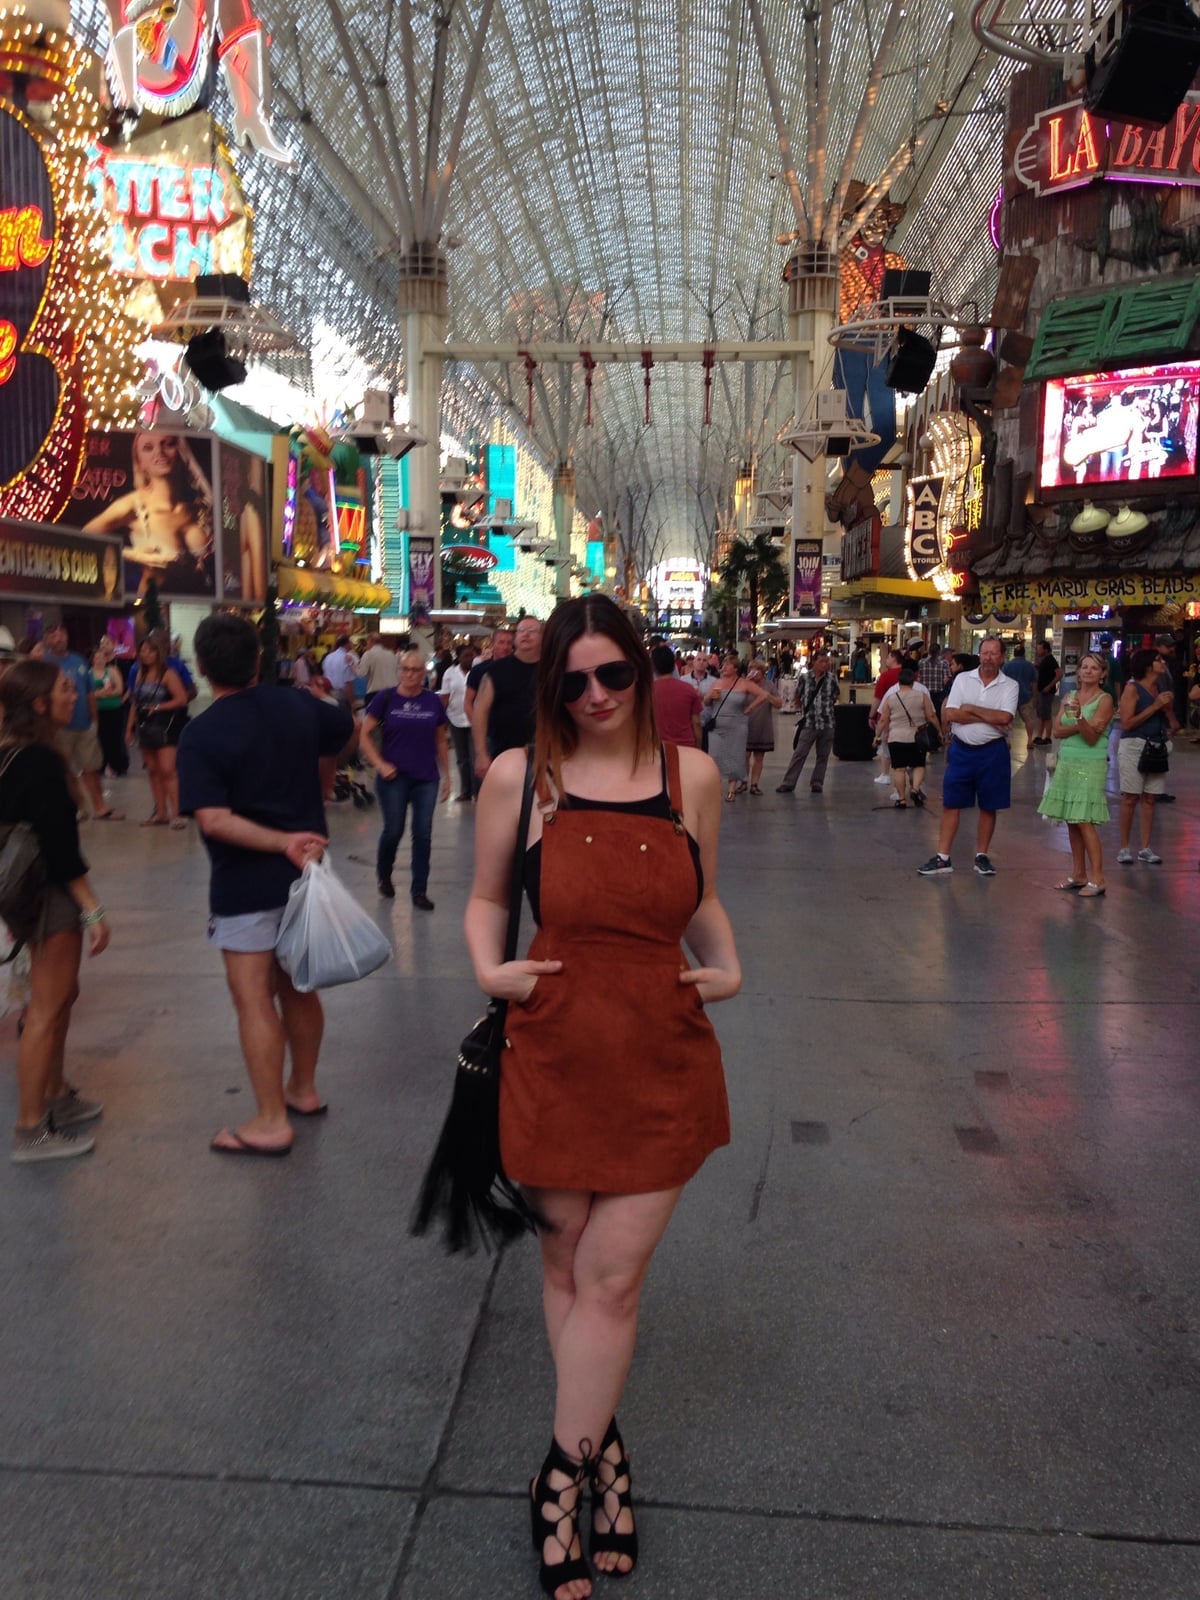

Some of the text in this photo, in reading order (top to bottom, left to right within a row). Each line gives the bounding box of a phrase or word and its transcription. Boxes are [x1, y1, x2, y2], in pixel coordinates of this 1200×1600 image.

[1048, 102, 1200, 182] LA BAY
[80, 466, 127, 488] ATED
[912, 483, 939, 555] ABC
[410, 552, 434, 569] FLY
[797, 556, 820, 569] JOIN
[799, 569, 816, 578] THE
[987, 581, 1031, 602] FREE
[1037, 580, 1089, 597] MARDI
[1095, 578, 1136, 596] GRAS
